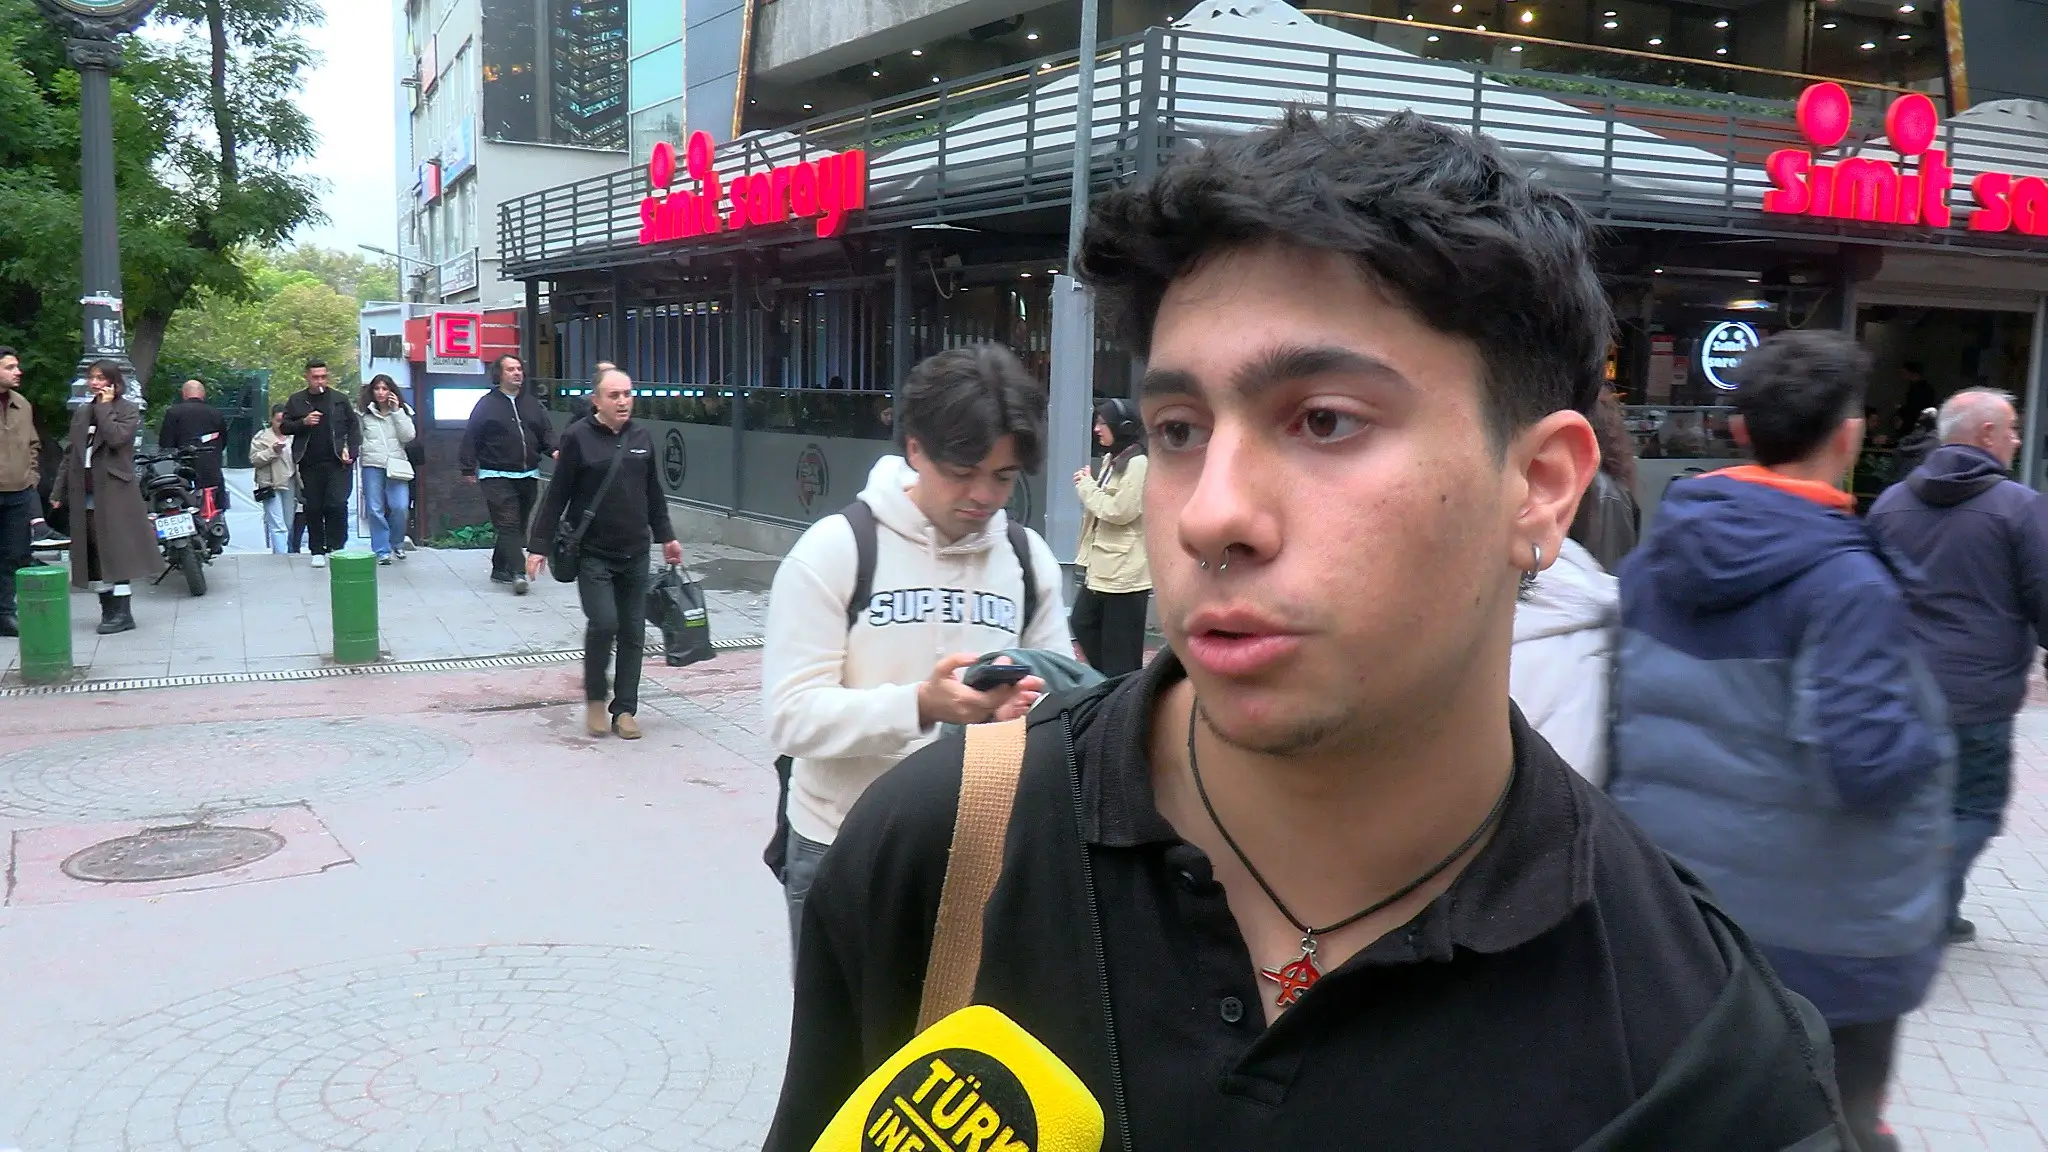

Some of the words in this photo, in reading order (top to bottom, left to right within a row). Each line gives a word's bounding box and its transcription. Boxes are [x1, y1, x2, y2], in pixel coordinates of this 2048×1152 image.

[639, 129, 722, 245] simit
[1763, 81, 1953, 229] simit
[445, 318, 472, 353] E
[868, 587, 1017, 634] SUPERIOR
